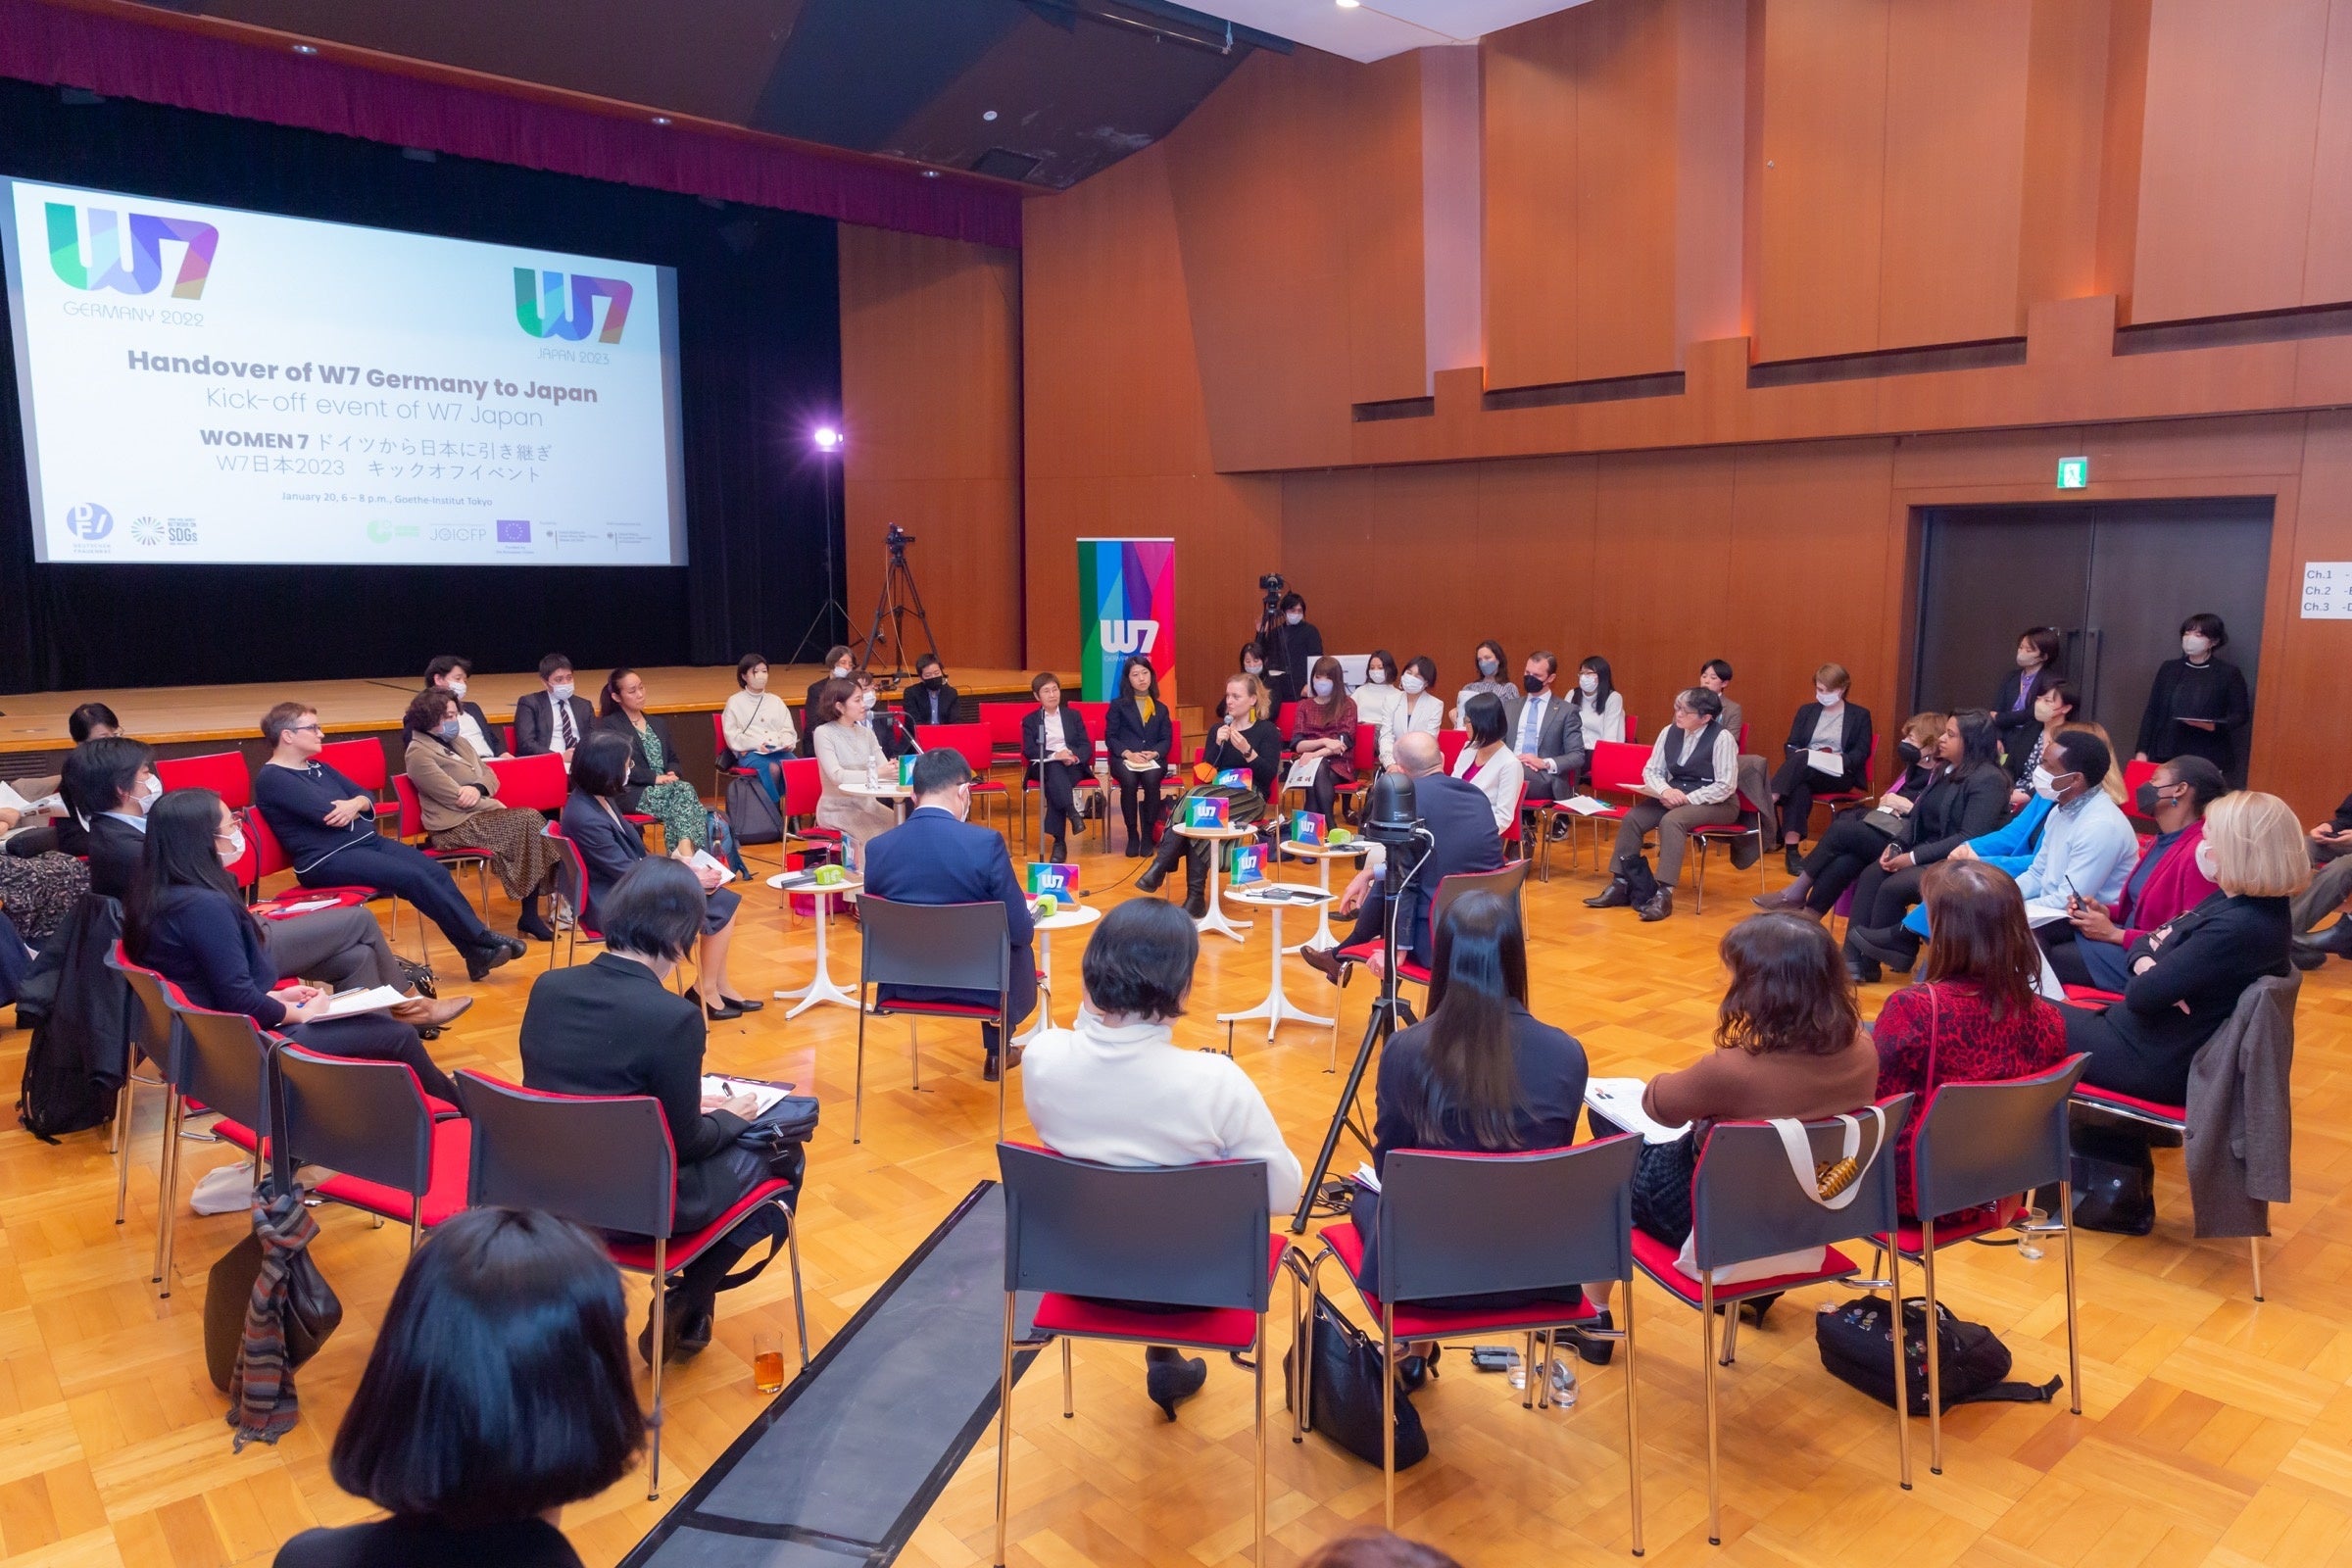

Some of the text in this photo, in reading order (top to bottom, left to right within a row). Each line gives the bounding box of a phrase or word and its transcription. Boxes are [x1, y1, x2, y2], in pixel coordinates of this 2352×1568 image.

[45, 202, 220, 300] W7
[63, 301, 204, 326] GERMANY 2022
[514, 267, 633, 344] W7
[537, 347, 610, 365] JAPAN 2023
[127, 350, 598, 406] Handover of W7 Germany to Japan
[207, 387, 543, 430] Kick-off event of W7 Japan
[200, 429, 552, 462] WOMEN 7 ドイツから日本に引き継ぎ
[217, 455, 540, 482] W7日本2023 キックオフイベント
[282, 492, 320, 503] January
[323, 493, 339, 503] 20,
[341, 493, 348, 502] 6
[359, 494, 366, 503] 8
[395, 495, 465, 505] Goethe-Institut
[467, 497, 493, 508] Tokyo
[169, 527, 198, 542] SDGs
[429, 527, 487, 541] JOICFP
[2306, 569, 2332, 579] Ch.1
[2305, 586, 2331, 596] Ch.2
[2303, 602, 2330, 612] Ch.3
[1100, 619, 1159, 654] W7
[1198, 806, 1217, 817] W7
[1300, 820, 1315, 833] W7
[1241, 856, 1257, 870] W7
[1041, 874, 1064, 889] W7
